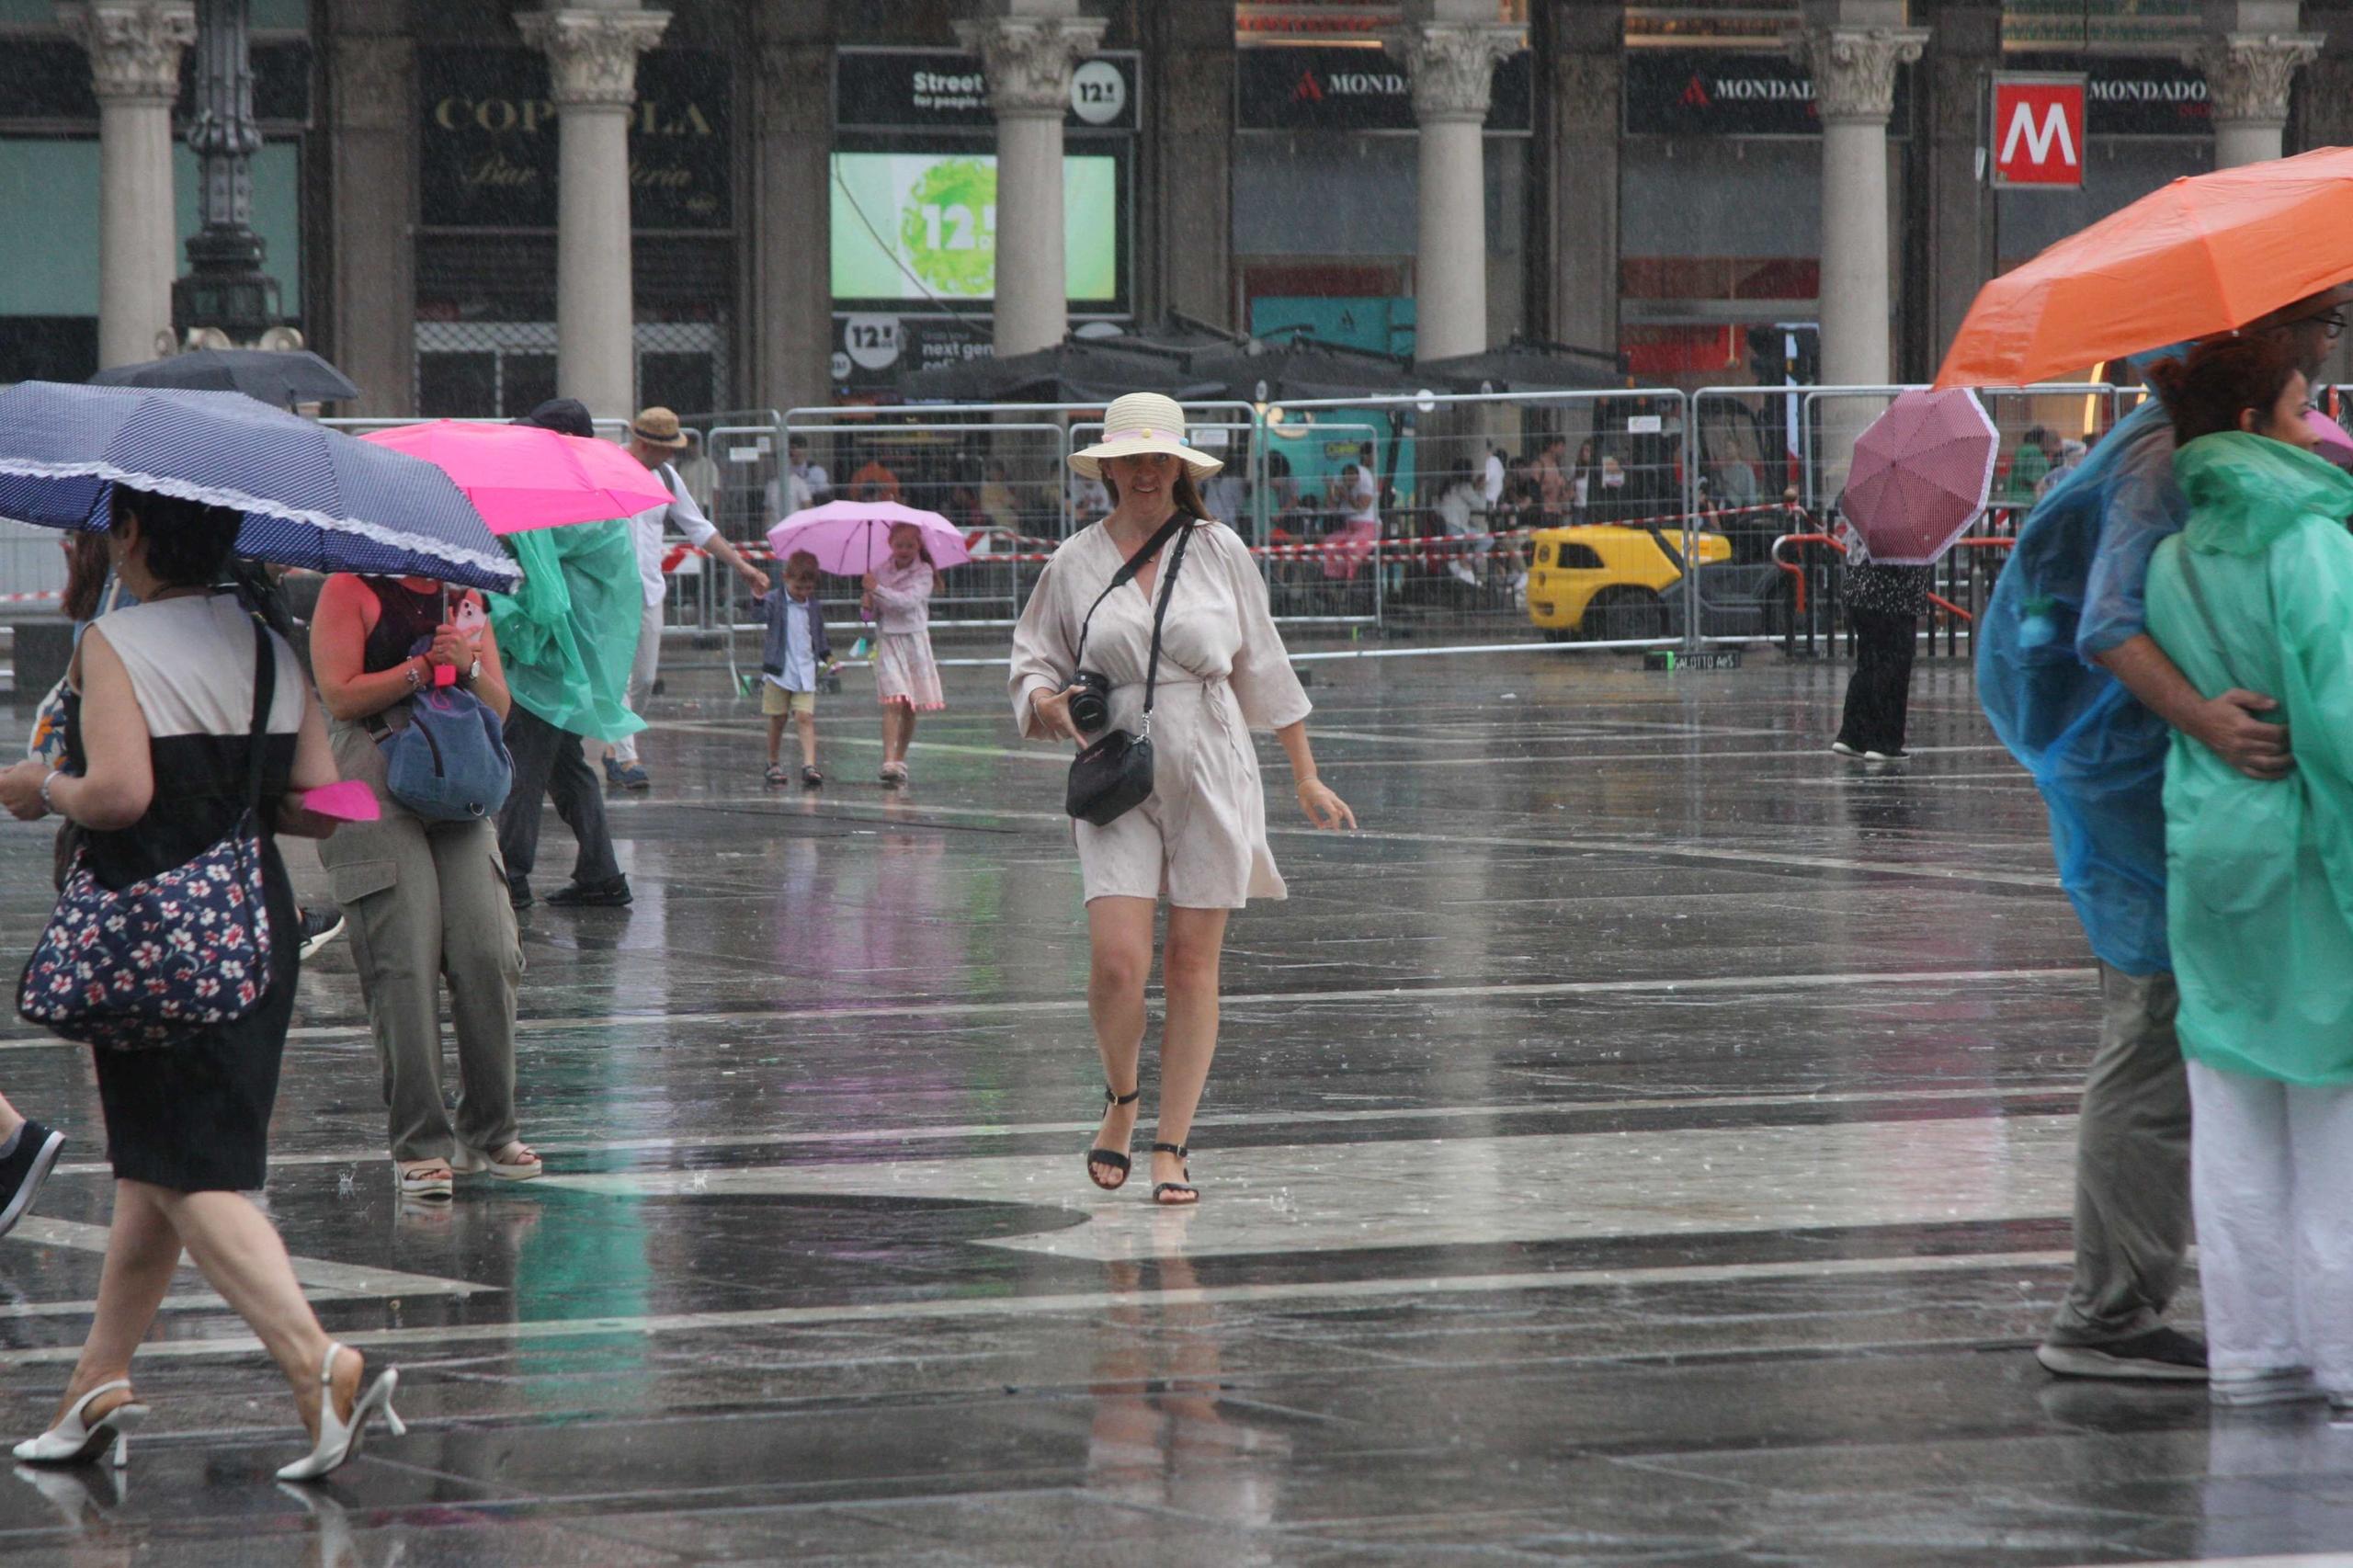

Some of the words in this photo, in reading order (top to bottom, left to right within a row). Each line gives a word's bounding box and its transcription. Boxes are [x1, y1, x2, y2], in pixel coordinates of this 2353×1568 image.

[913, 72, 983, 92] Street
[2000, 101, 2077, 165] M
[922, 341, 960, 358] next
